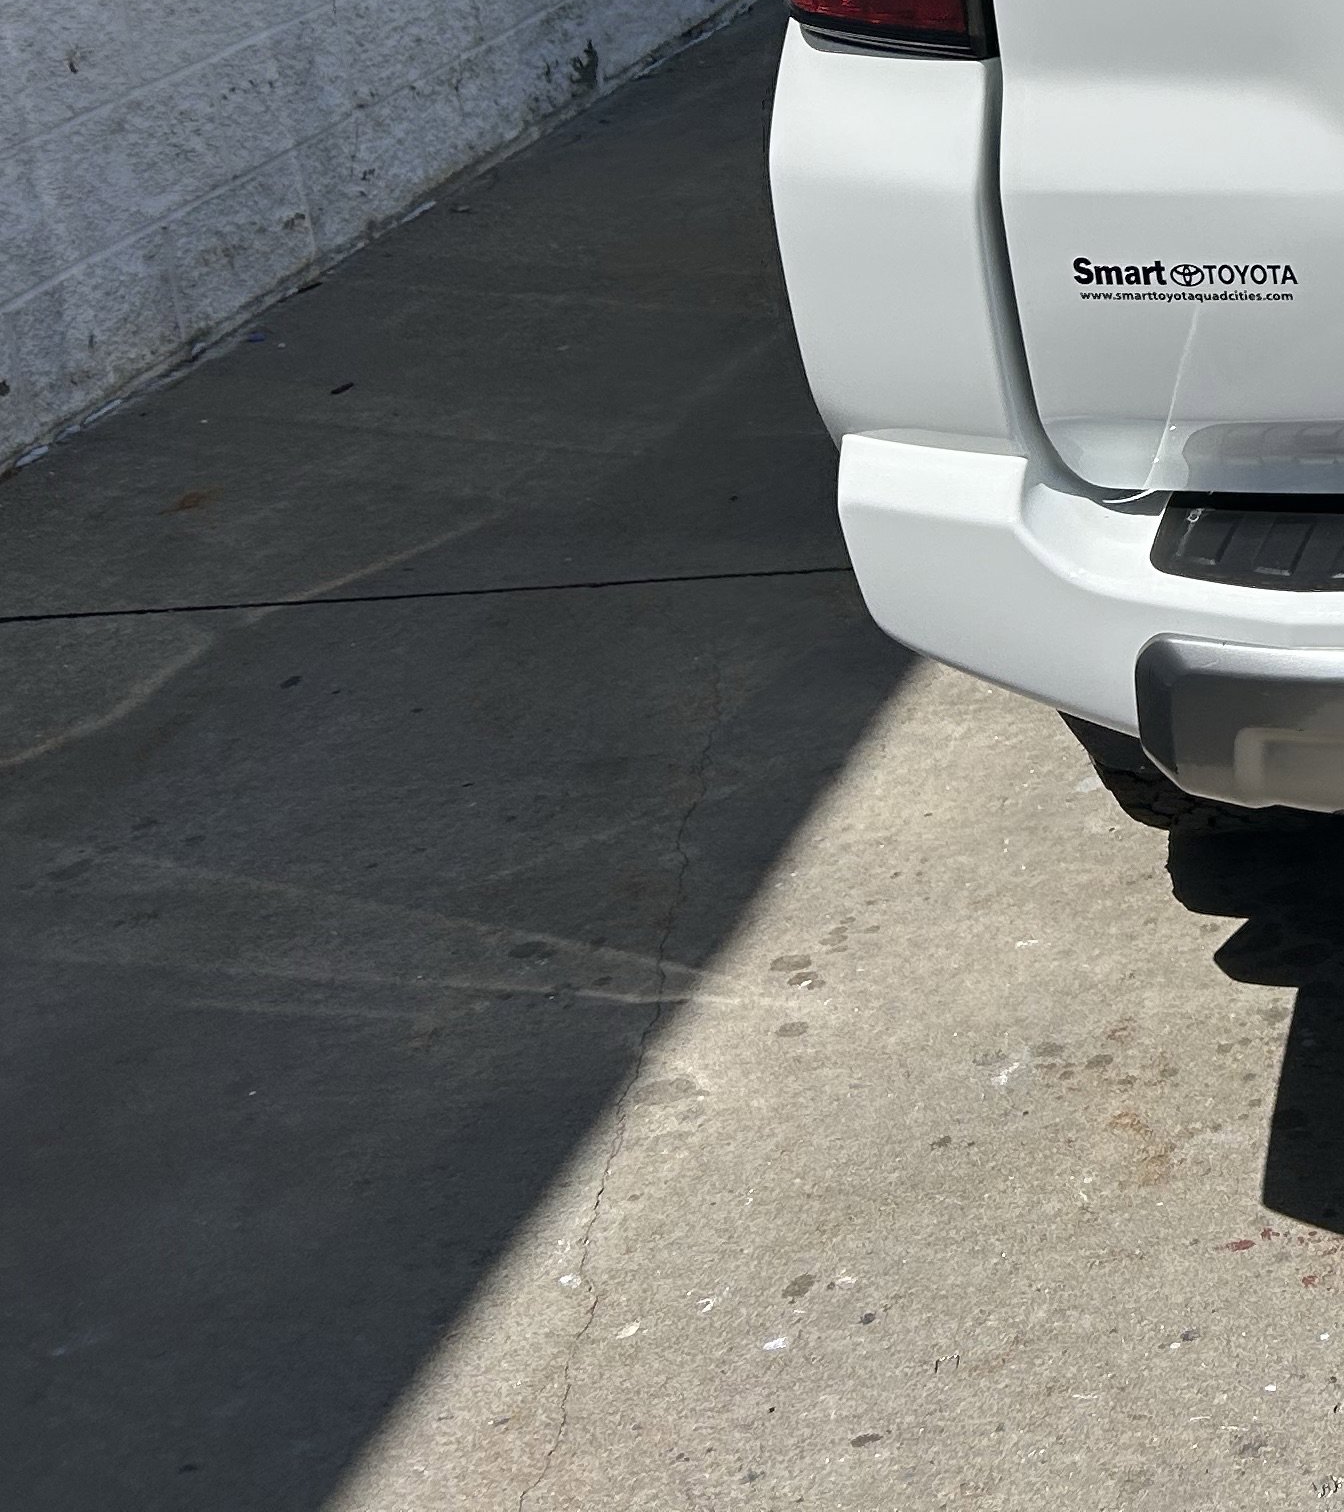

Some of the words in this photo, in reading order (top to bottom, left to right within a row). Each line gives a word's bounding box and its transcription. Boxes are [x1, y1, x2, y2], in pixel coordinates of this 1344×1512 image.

[1072, 257, 1168, 286] Smart
[1202, 264, 1299, 286] TOYOTA
[1080, 290, 1294, 304] www.smarttoyotaquadcities.com
